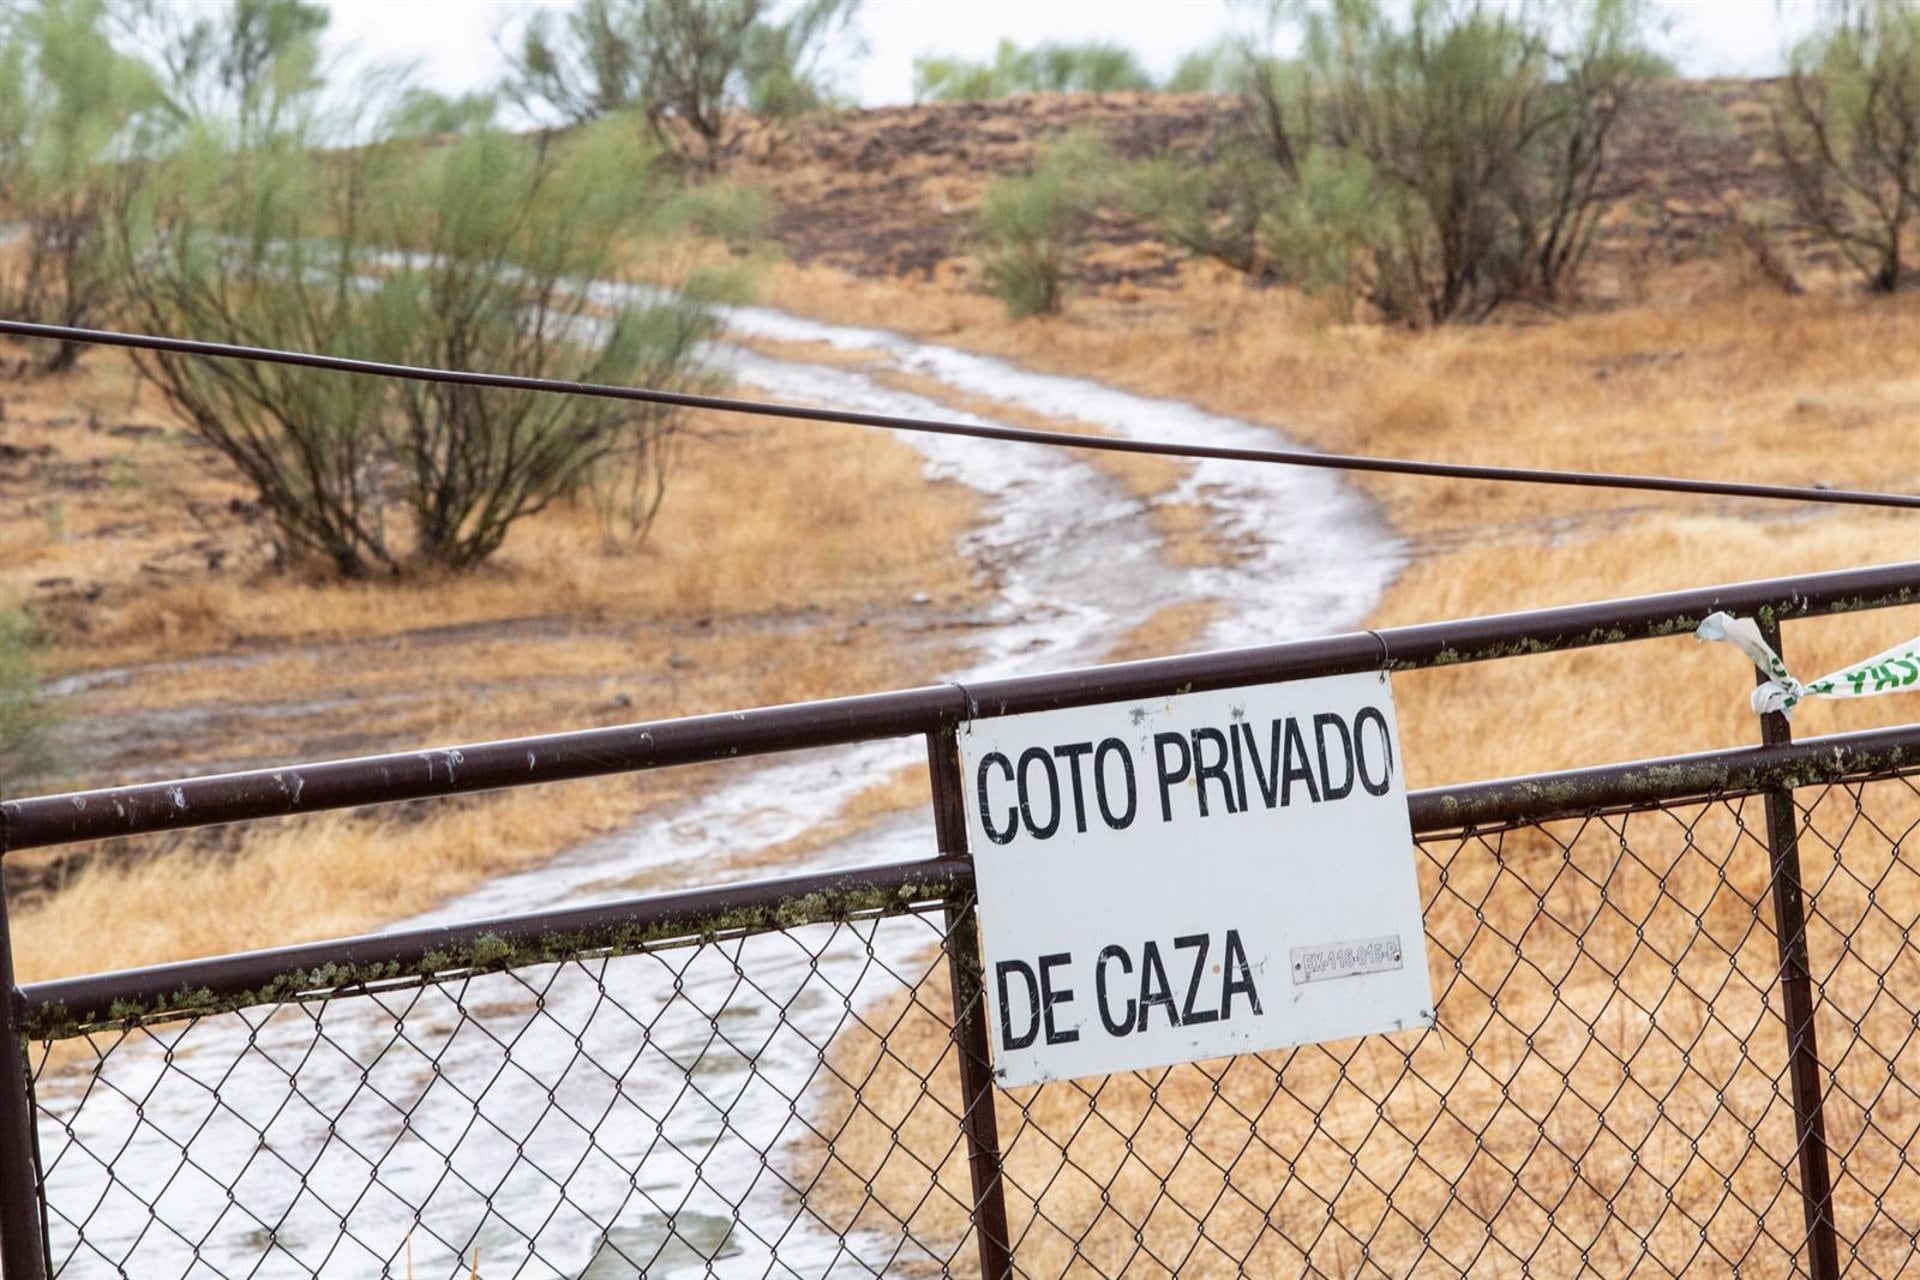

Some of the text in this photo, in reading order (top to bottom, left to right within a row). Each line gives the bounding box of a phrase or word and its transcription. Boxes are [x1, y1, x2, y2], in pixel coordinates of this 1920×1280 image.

[977, 706, 1394, 845] COTO PRIVADO
[995, 929, 1264, 1052] DE CAZA
